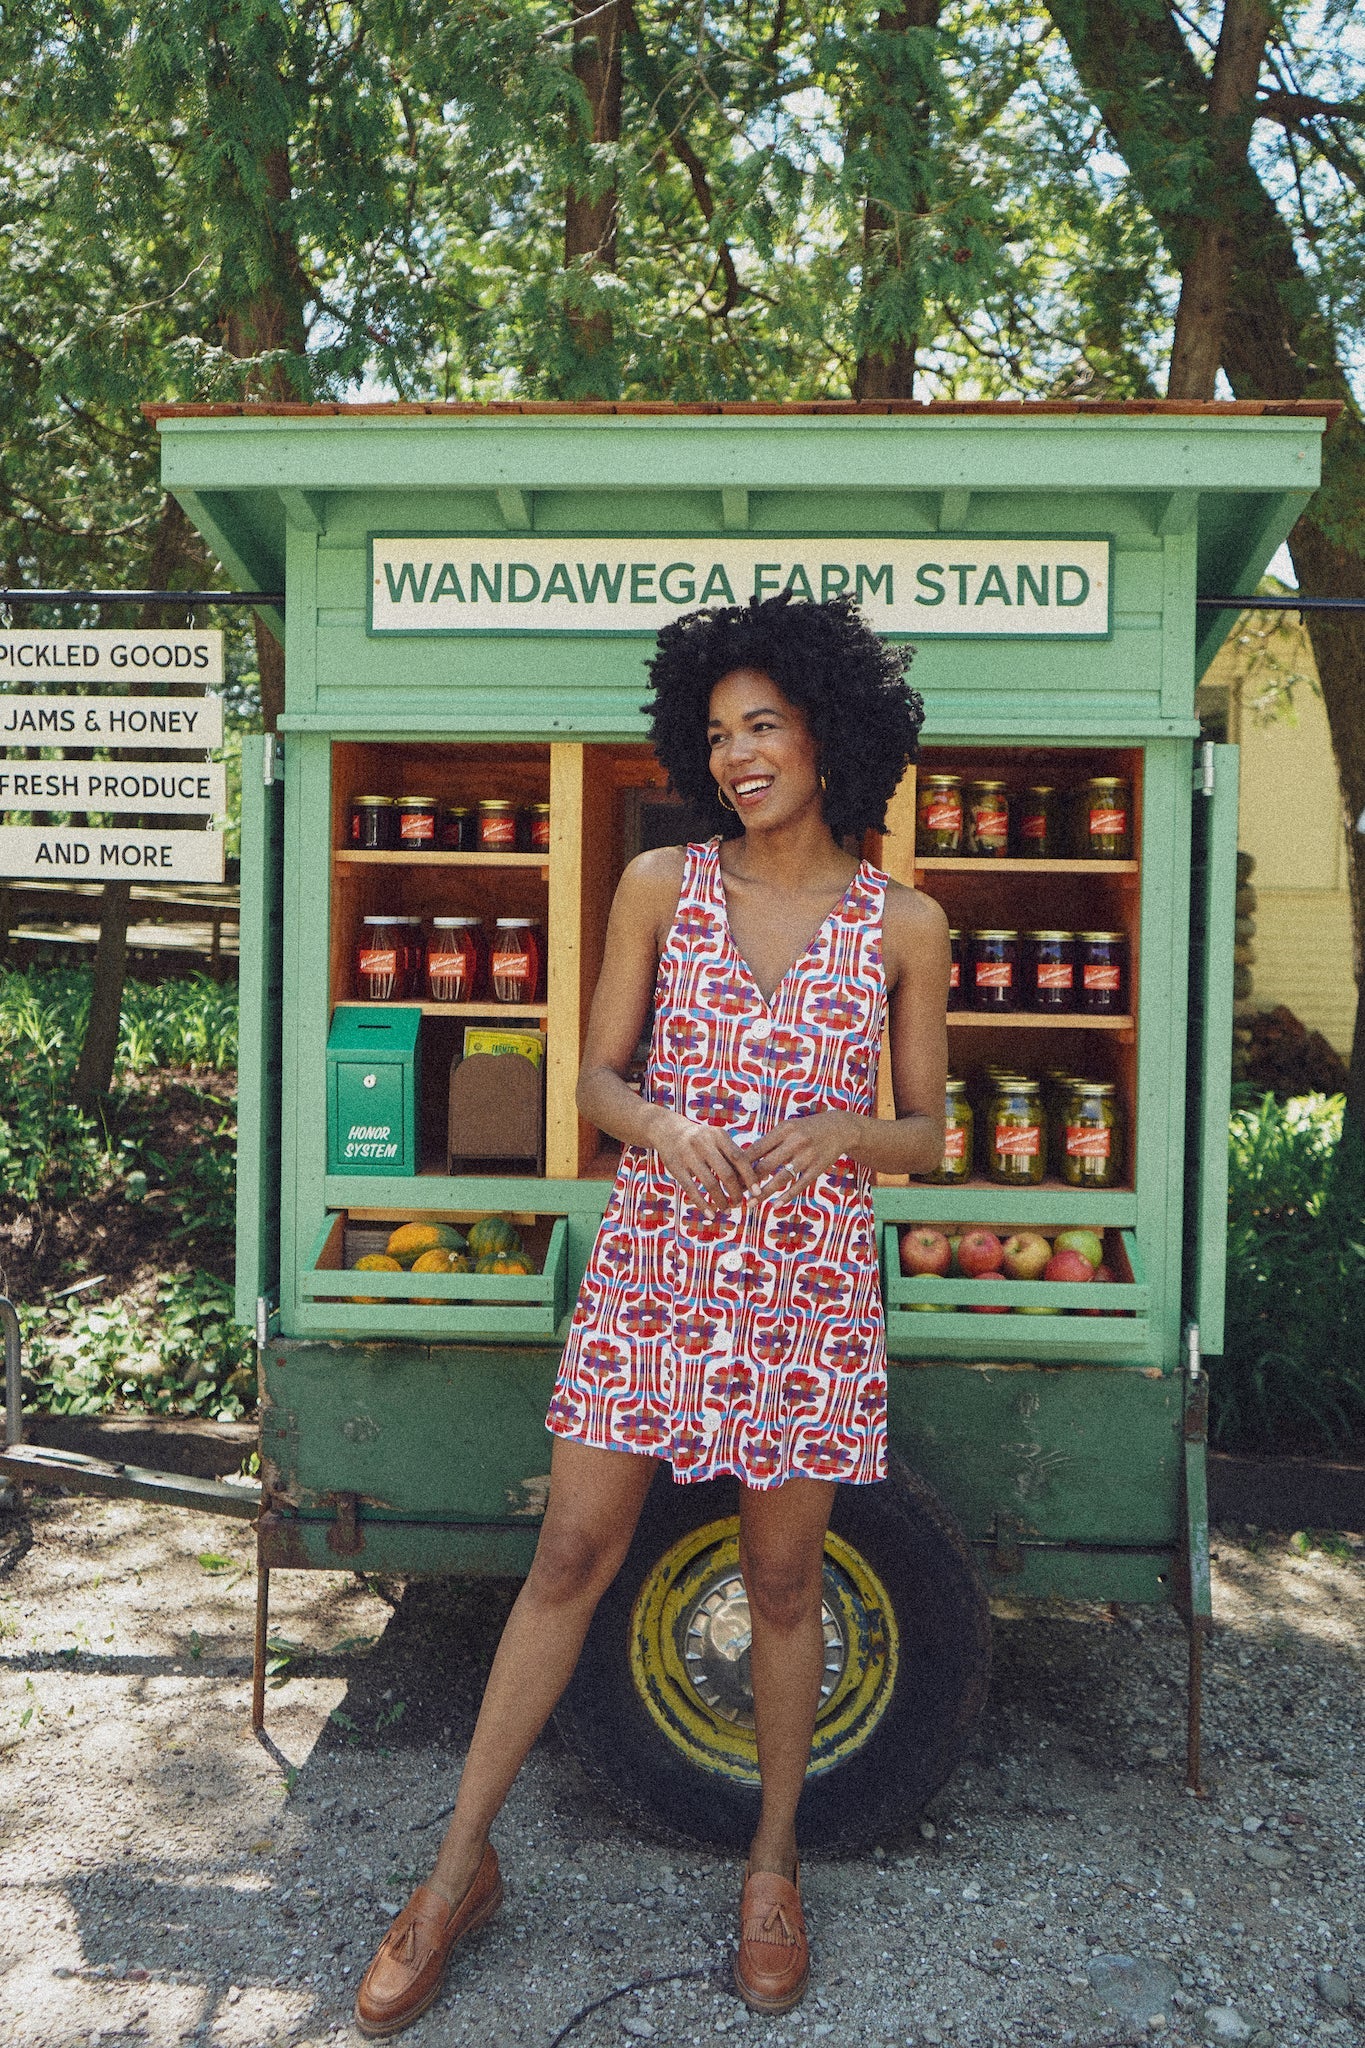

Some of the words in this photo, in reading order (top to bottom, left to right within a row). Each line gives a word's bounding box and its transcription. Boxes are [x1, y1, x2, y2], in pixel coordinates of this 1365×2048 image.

[384, 562, 736, 604] WANDAWEGA
[754, 563, 894, 605] FARM
[914, 562, 1090, 607] STAND
[110, 644, 209, 668] GOODS
[4, 709, 75, 732] JAMS
[84, 710, 101, 732] &
[109, 710, 199, 733] HONEY
[0, 774, 79, 796] FRESH
[89, 776, 211, 799] PRODUCE
[35, 842, 90, 865] AND
[100, 844, 173, 867] MORE
[348, 1125, 391, 1141] HONOR
[344, 1142, 398, 1158] SYSTEM
